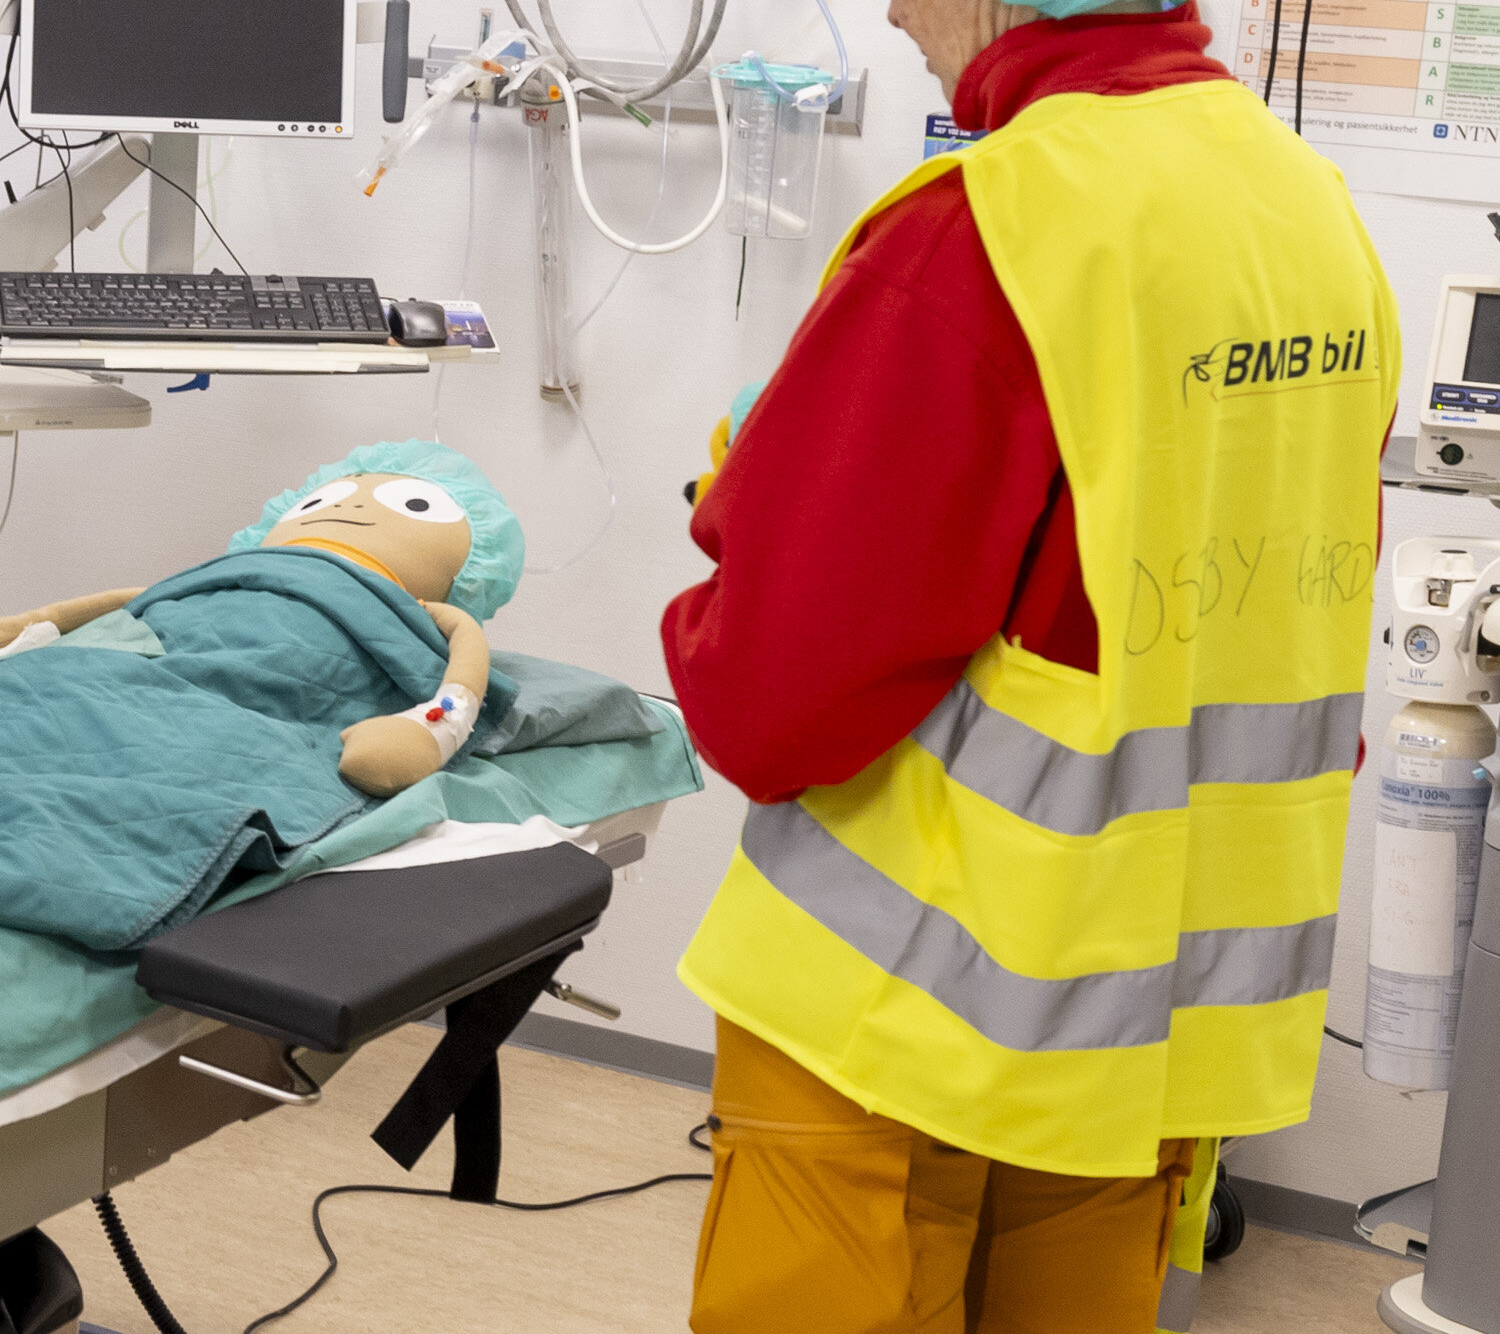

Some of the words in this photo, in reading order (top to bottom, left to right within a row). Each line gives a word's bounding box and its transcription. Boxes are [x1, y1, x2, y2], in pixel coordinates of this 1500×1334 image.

[1437, 8, 1445, 20] S
[1248, 25, 1257, 36] C
[1432, 37, 1442, 48] B
[1244, 53, 1254, 64] D
[1428, 67, 1438, 78] A
[1425, 95, 1435, 106] R
[174, 121, 199, 129] DELL
[1287, 116, 1332, 129] siulering
[1334, 121, 1345, 130] og
[1346, 120, 1418, 134] pasientsikkerhet
[1223, 335, 1313, 387] BMB
[1322, 329, 1366, 374] bil
[1409, 667, 1424, 679] LIV
[1418, 788, 1451, 802] 100%
